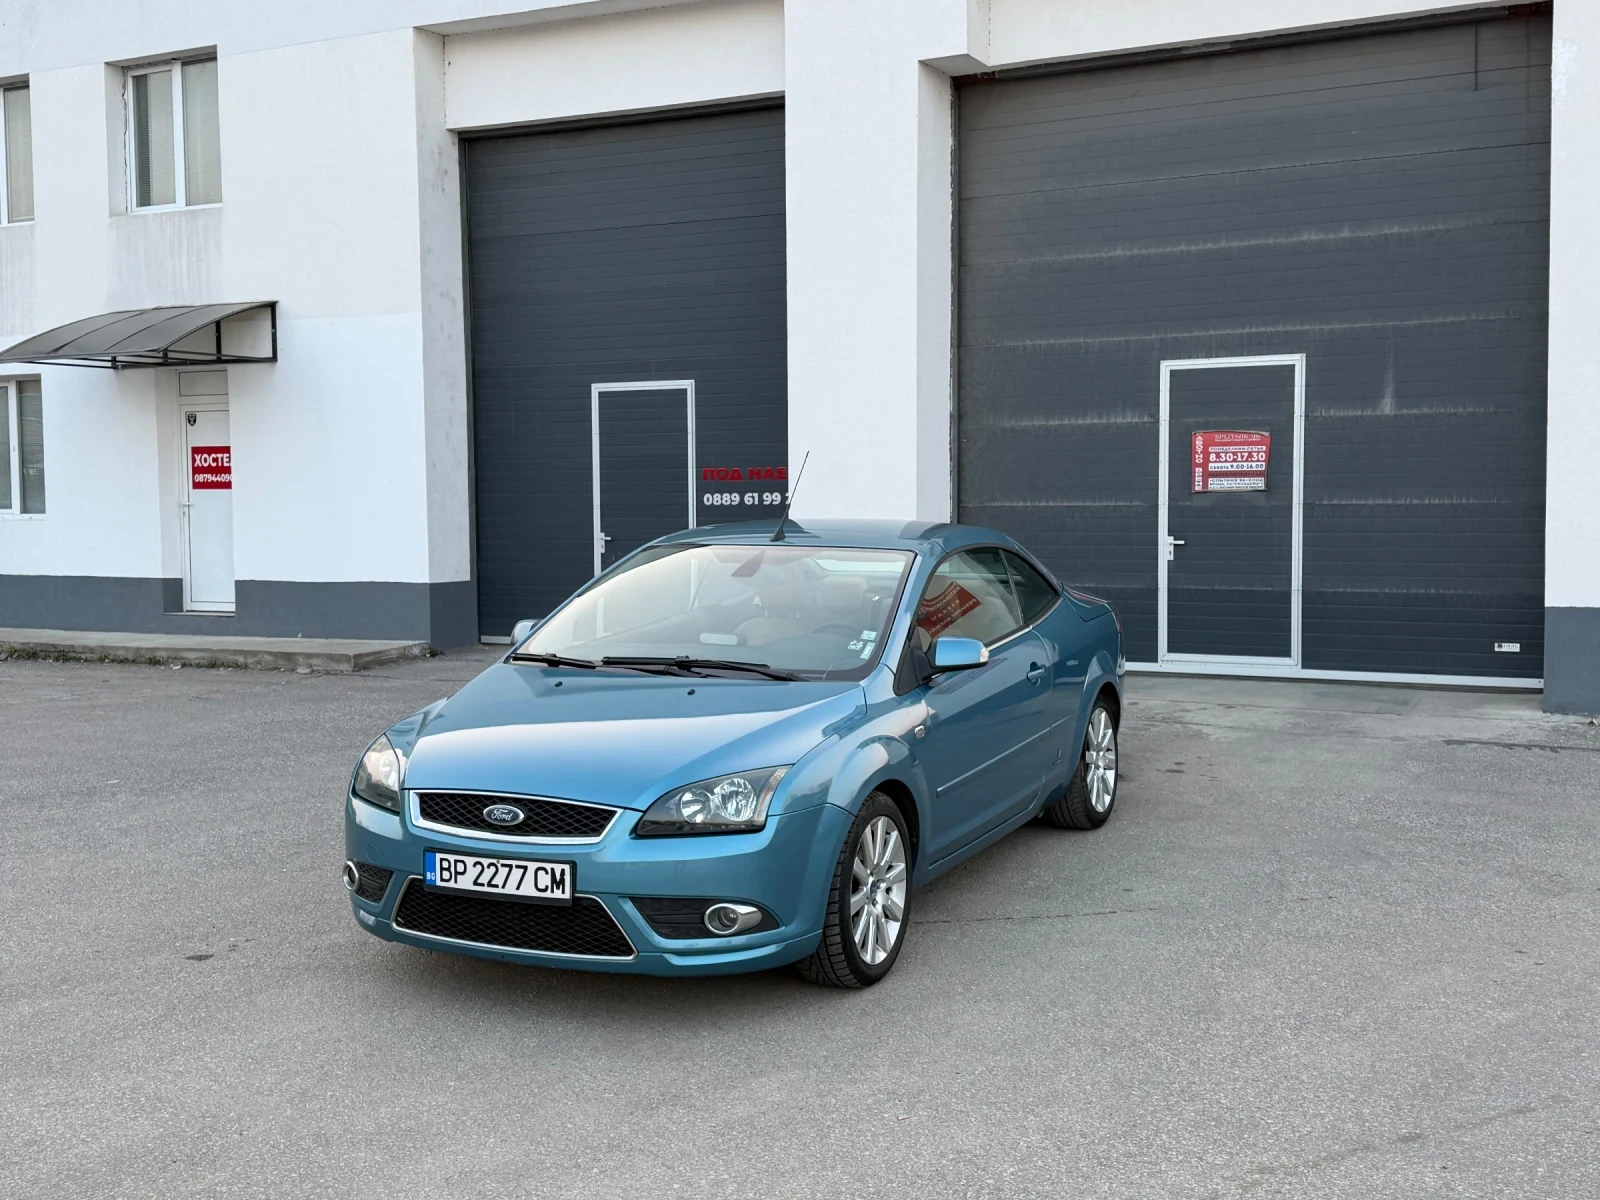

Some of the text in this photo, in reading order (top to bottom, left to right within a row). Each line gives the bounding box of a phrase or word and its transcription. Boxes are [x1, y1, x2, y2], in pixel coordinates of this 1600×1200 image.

[194, 453, 232, 467] ХОСТЕ
[1209, 452, 1266, 461] 8.30-17.30
[702, 467, 744, 481] ПОД
[703, 493, 740, 506] 0889
[744, 492, 758, 505] 61
[763, 492, 781, 505] 99
[491, 808, 513, 820] Ford
[426, 872, 435, 880] BG
[439, 857, 566, 895] BP 2277 CM
